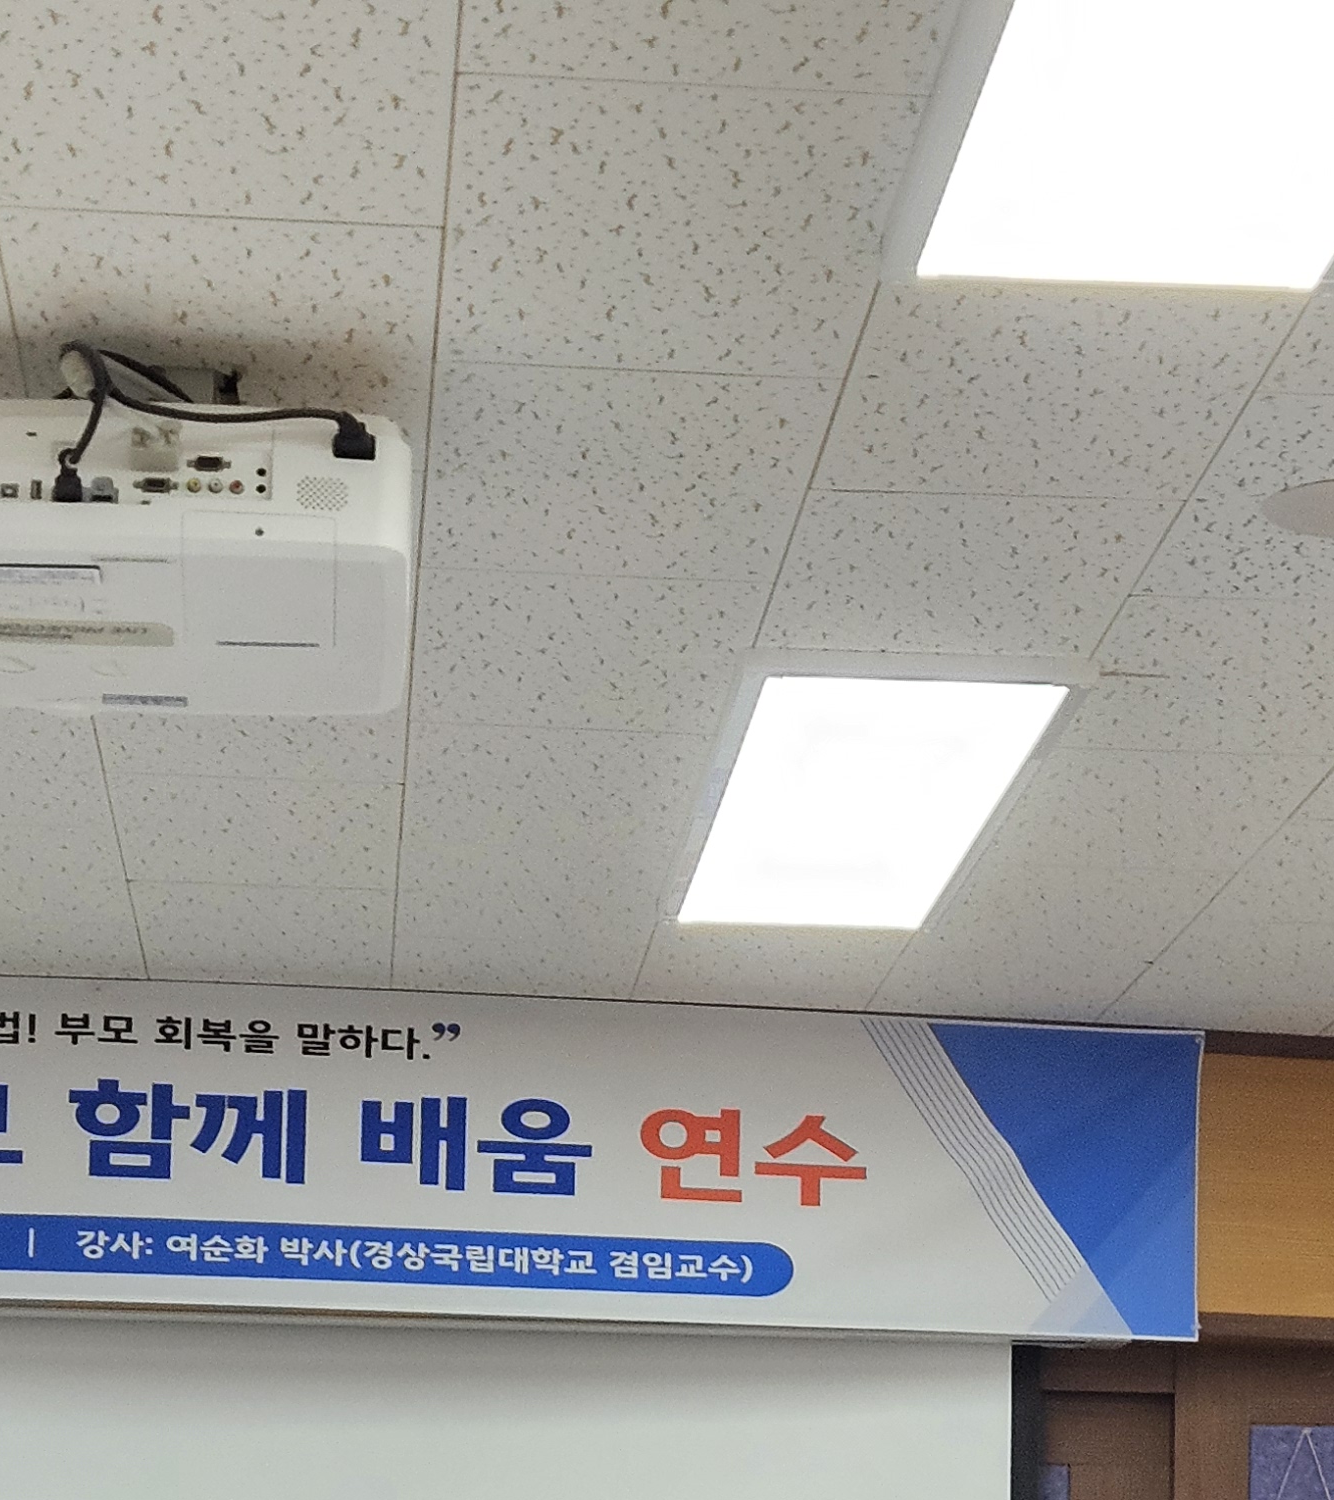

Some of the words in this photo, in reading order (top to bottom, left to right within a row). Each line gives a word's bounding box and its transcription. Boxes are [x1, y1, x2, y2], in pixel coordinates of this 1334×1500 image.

[54, 1012, 139, 1045] 부모
[154, 1015, 280, 1054] 회복을
[69, 1079, 307, 1184] 함께
[360, 1096, 592, 1195] 배움
[640, 1108, 867, 1206] 연수
[76, 1230, 153, 1259] 강사:
[166, 1234, 269, 1264] 여순화
[280, 1237, 598, 1276] 박사(경상국립대학교
[609, 1250, 754, 1284] 겸임교수)
